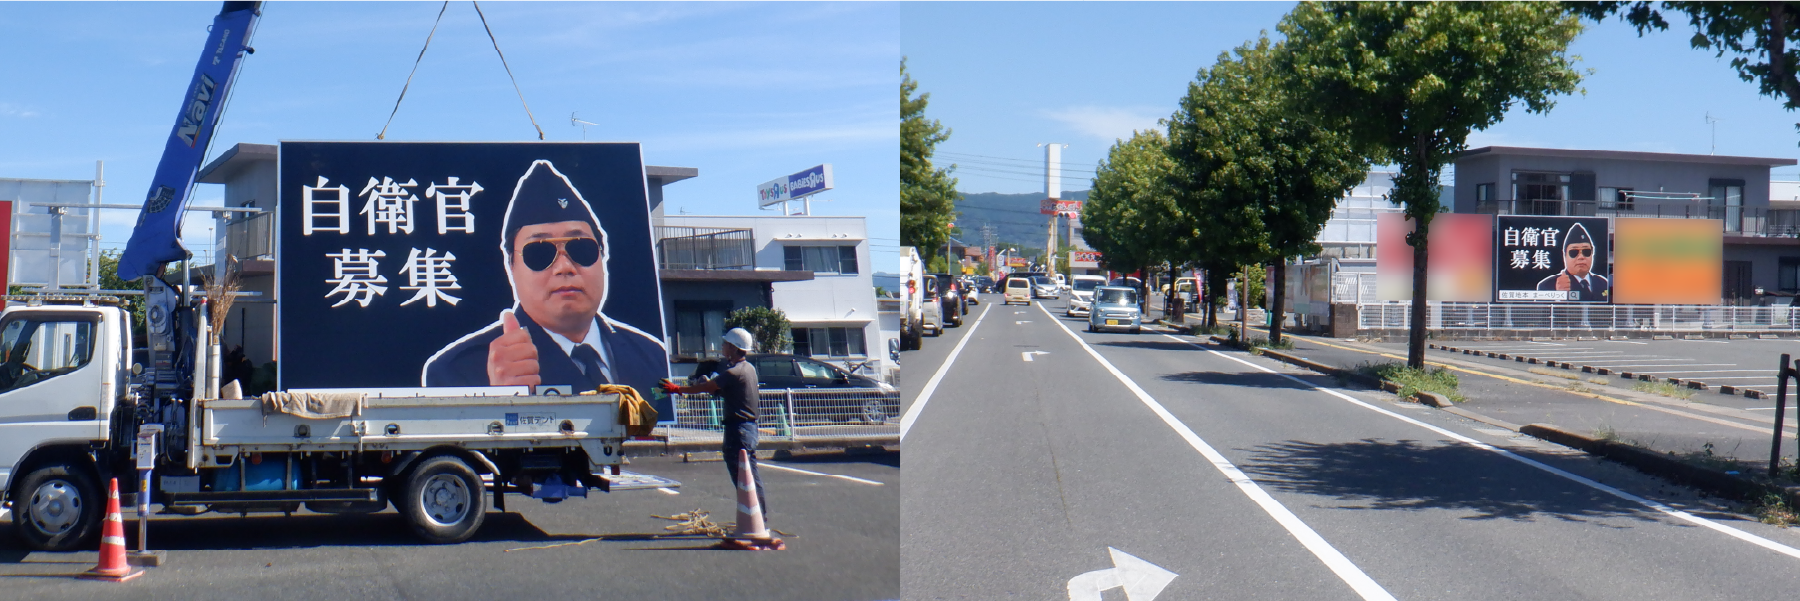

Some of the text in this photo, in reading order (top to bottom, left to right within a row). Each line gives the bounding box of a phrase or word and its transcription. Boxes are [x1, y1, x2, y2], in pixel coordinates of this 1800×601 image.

[177, 73, 216, 147] Navi
[303, 175, 485, 236] 自衛官
[1504, 226, 1560, 247] 自衛官
[325, 247, 462, 308] 募集
[1510, 249, 1551, 269] 募集
[519, 416, 554, 425] 佐賀テント
